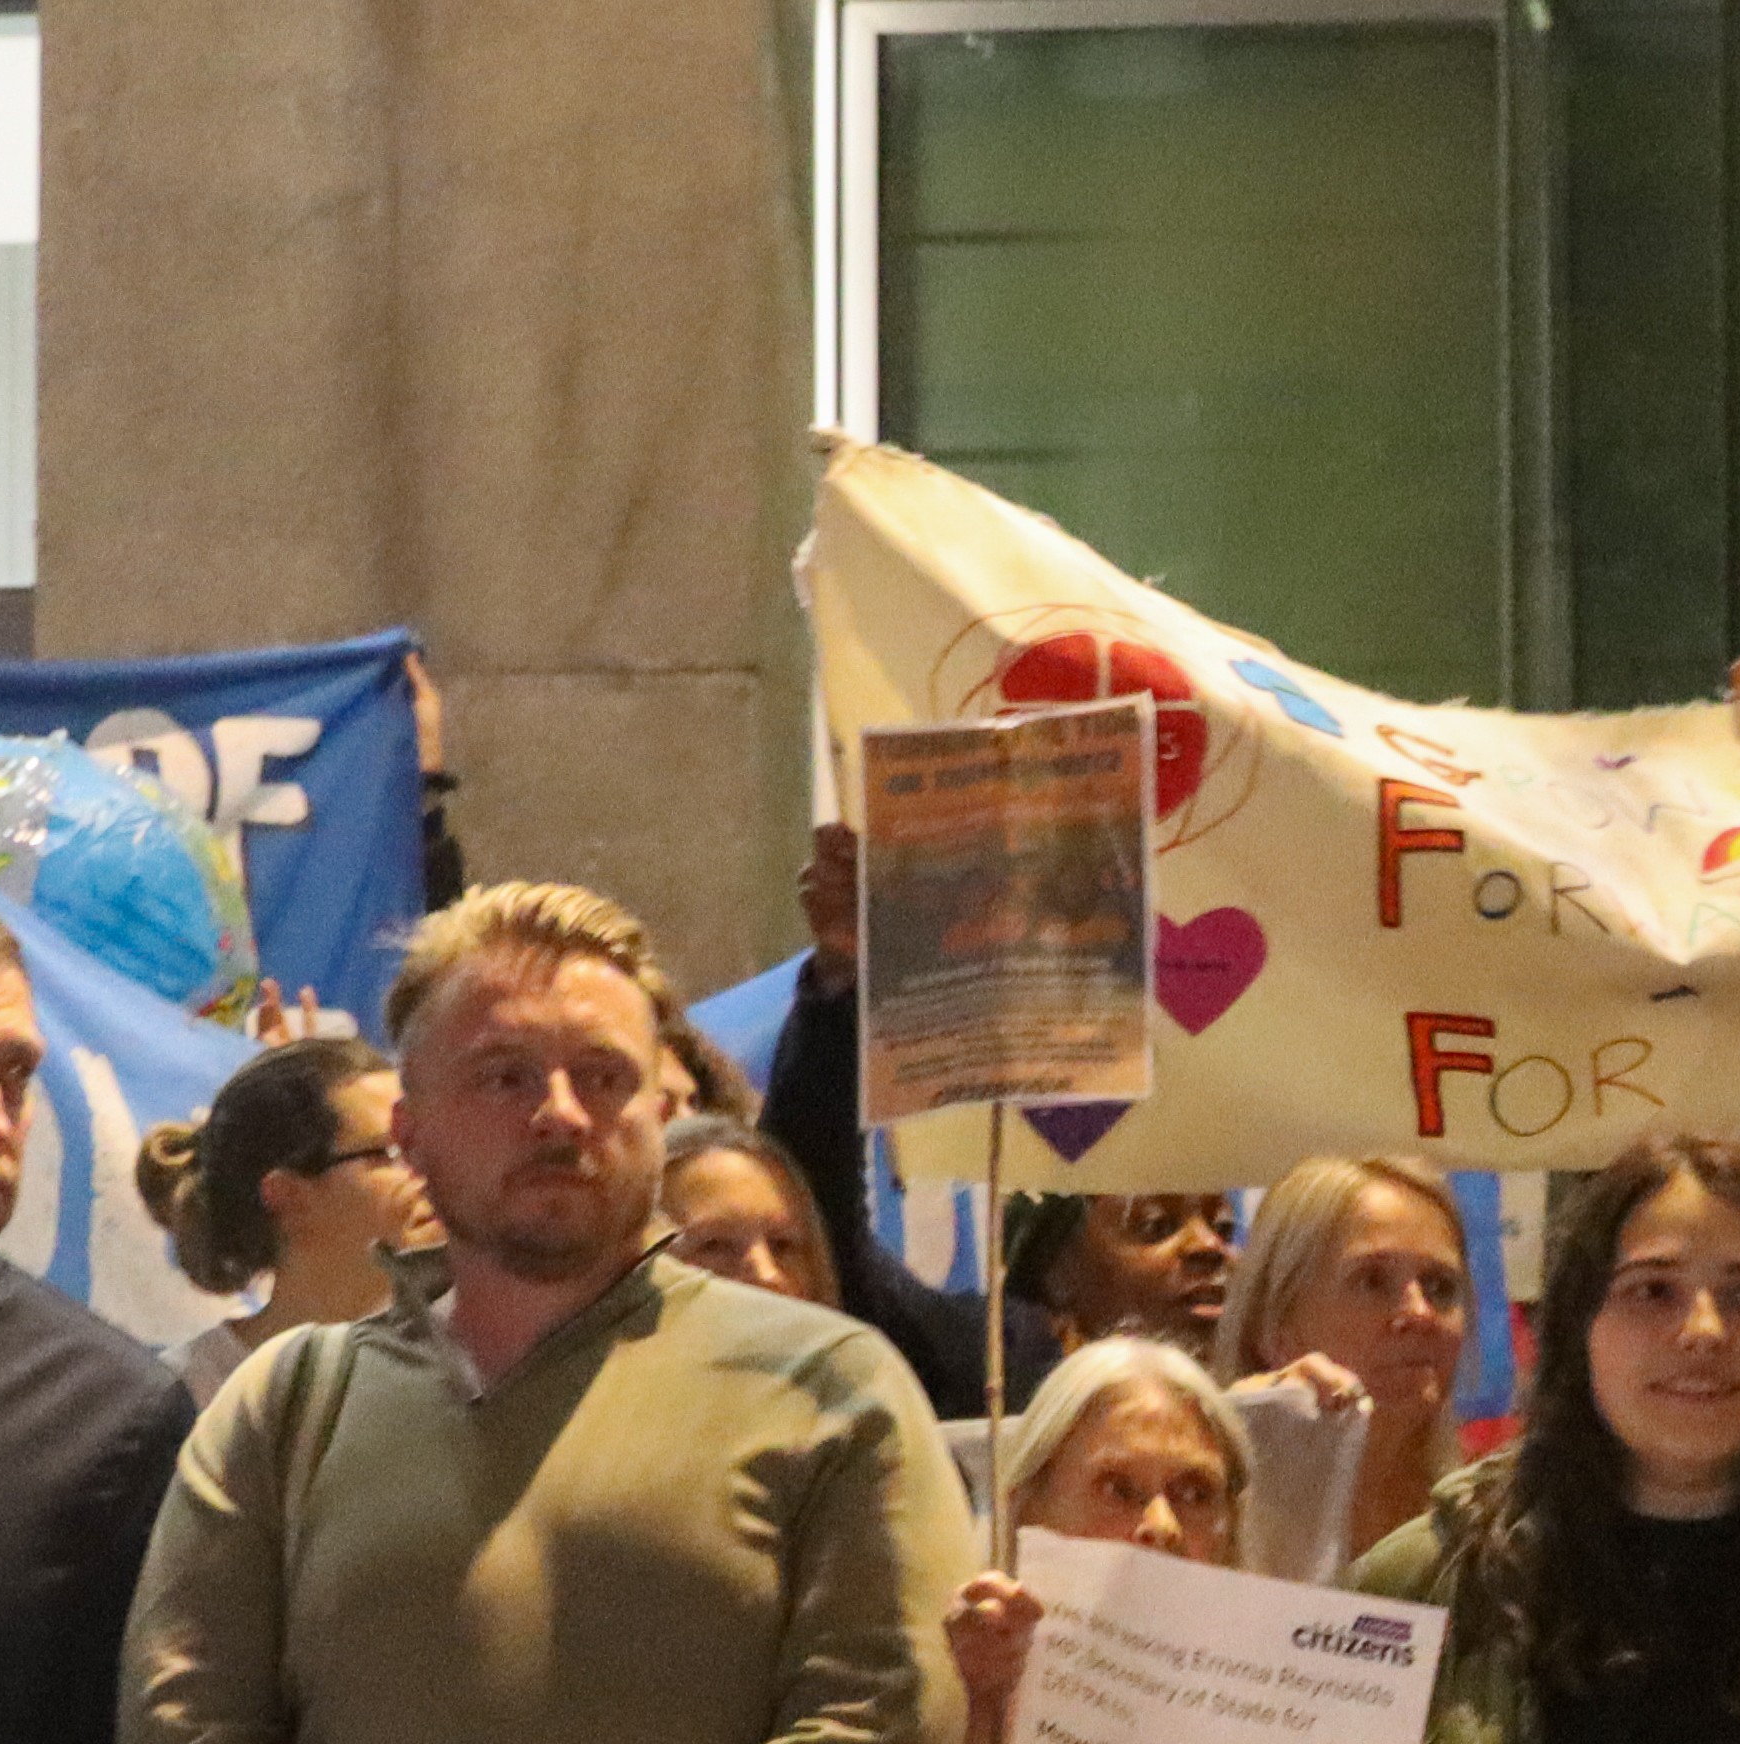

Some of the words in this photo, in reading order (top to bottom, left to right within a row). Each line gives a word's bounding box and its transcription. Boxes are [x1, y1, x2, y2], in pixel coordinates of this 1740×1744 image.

[1405, 1010, 1666, 1138] FOR
[1292, 1622, 1416, 1667] citizens
[1191, 1648, 1271, 1684] Emma
[1278, 1665, 1395, 1708] Reynolds
